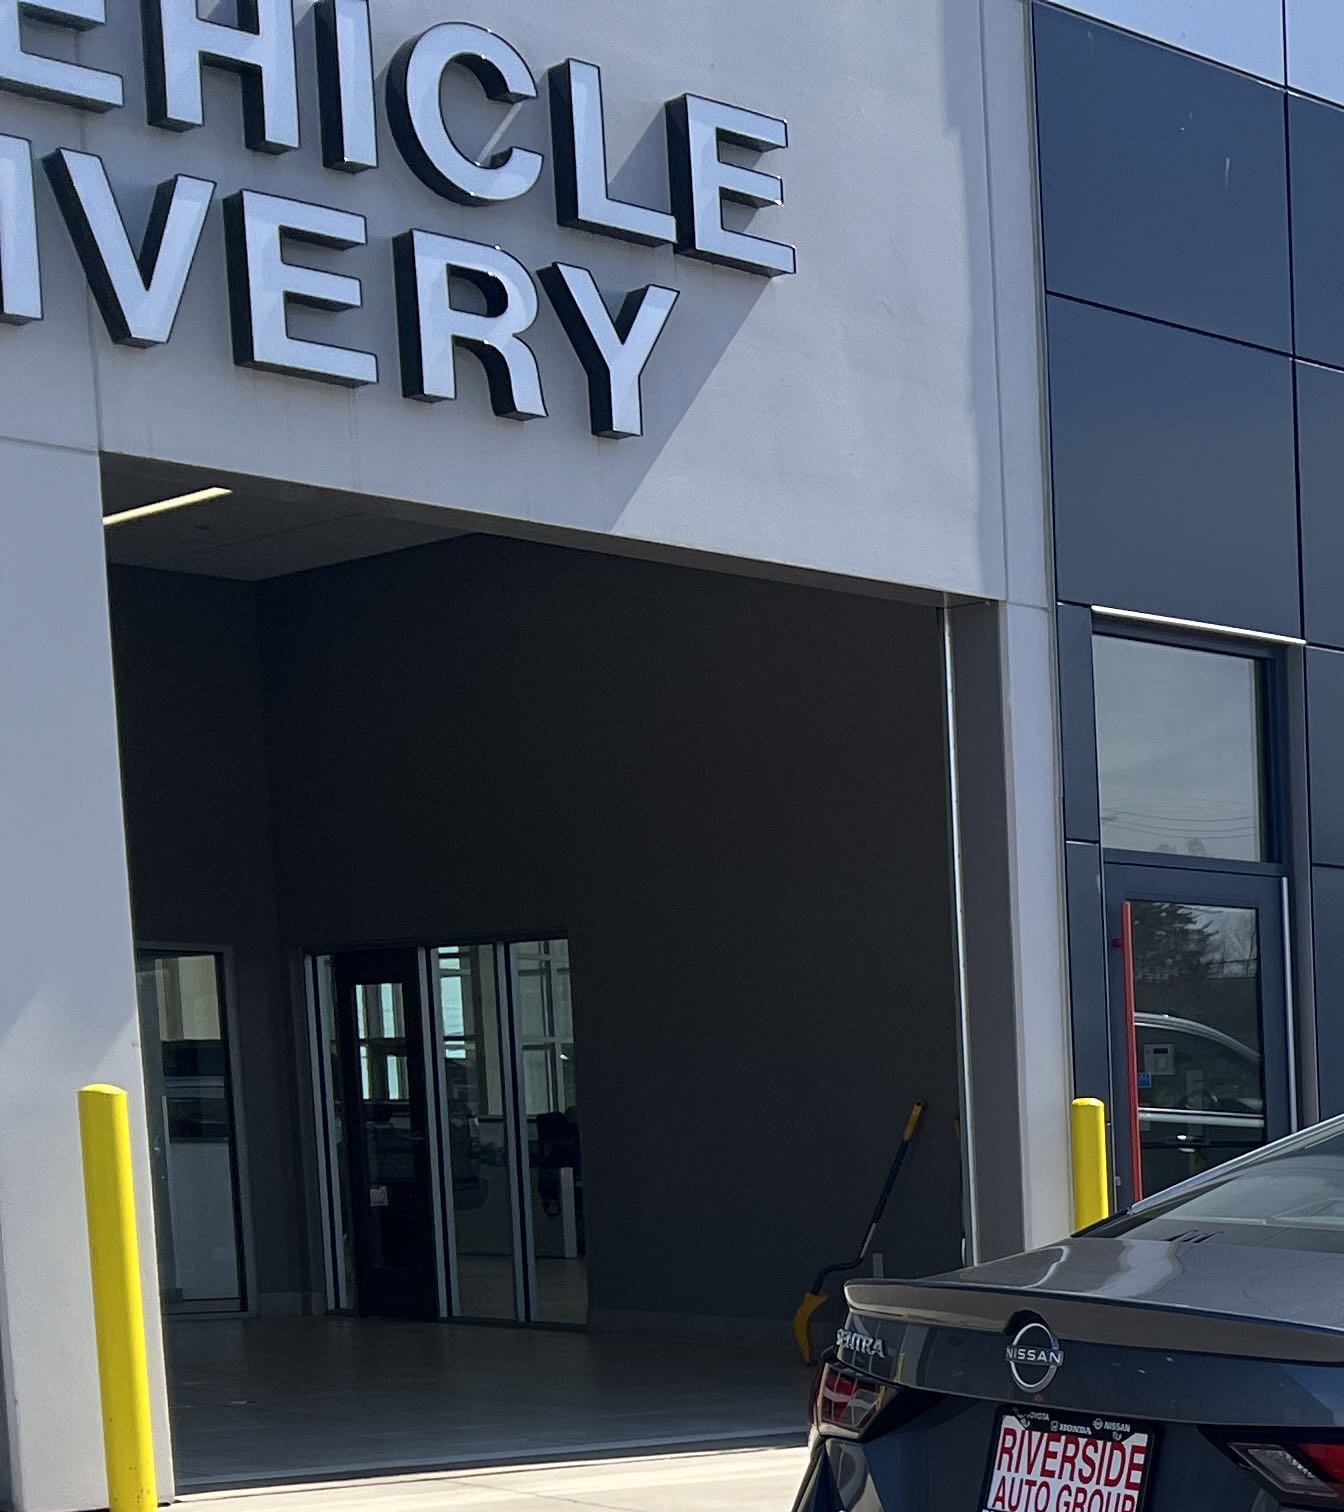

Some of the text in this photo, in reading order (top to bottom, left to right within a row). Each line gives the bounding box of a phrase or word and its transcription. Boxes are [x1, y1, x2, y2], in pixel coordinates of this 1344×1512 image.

[1006, 1347, 1061, 1364] NISSAN
[1059, 1423, 1092, 1435] HONDA
[1104, 1421, 1131, 1432] NISSAN
[996, 1427, 1148, 1491] RIVERSIDE
